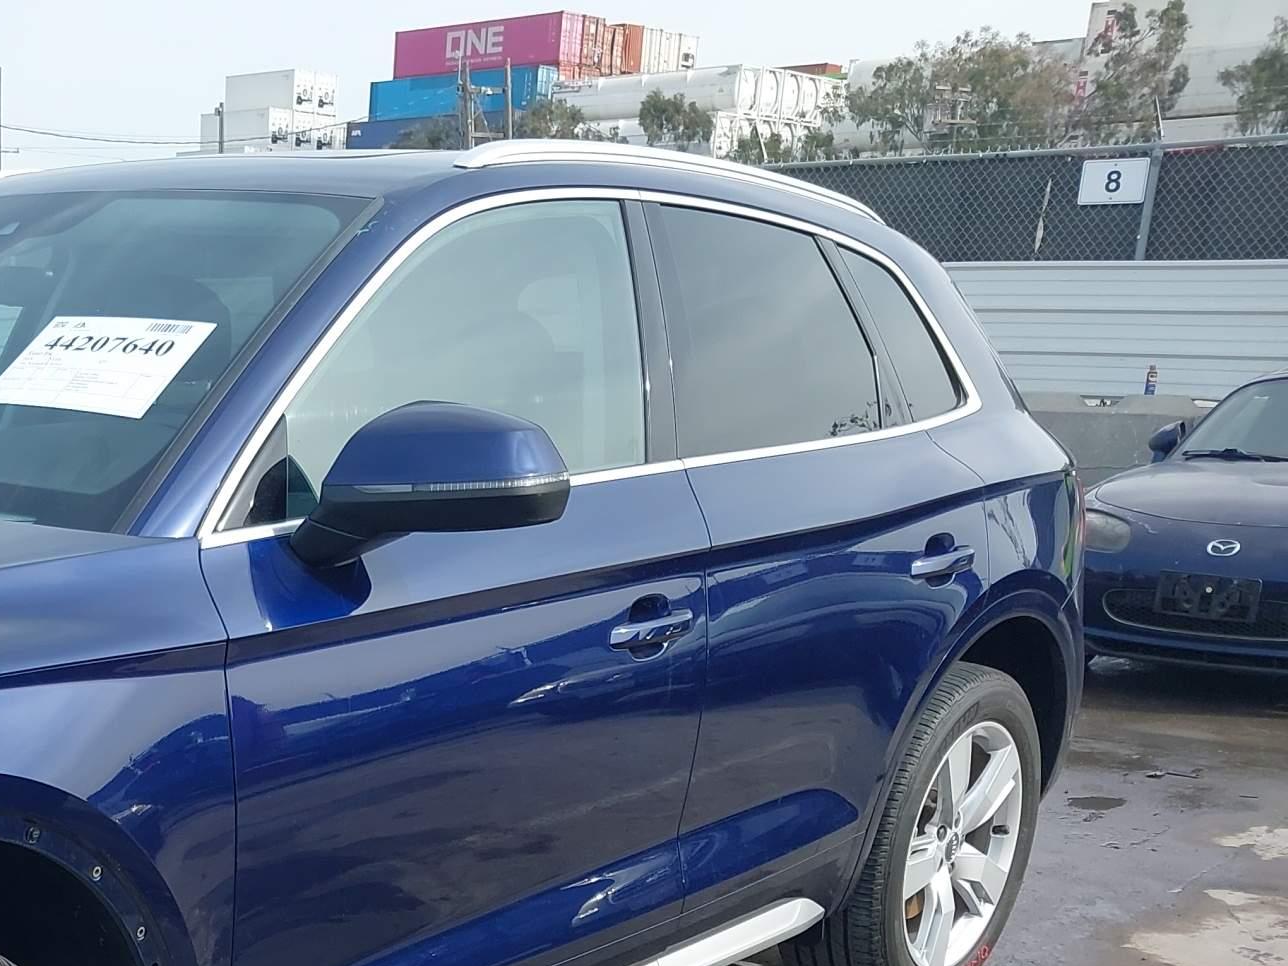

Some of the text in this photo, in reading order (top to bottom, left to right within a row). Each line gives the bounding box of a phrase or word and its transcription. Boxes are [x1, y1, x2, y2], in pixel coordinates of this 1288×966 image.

[445, 26, 505, 58] ONE
[1104, 170, 1122, 193] 8
[44, 335, 176, 357] 44207640
